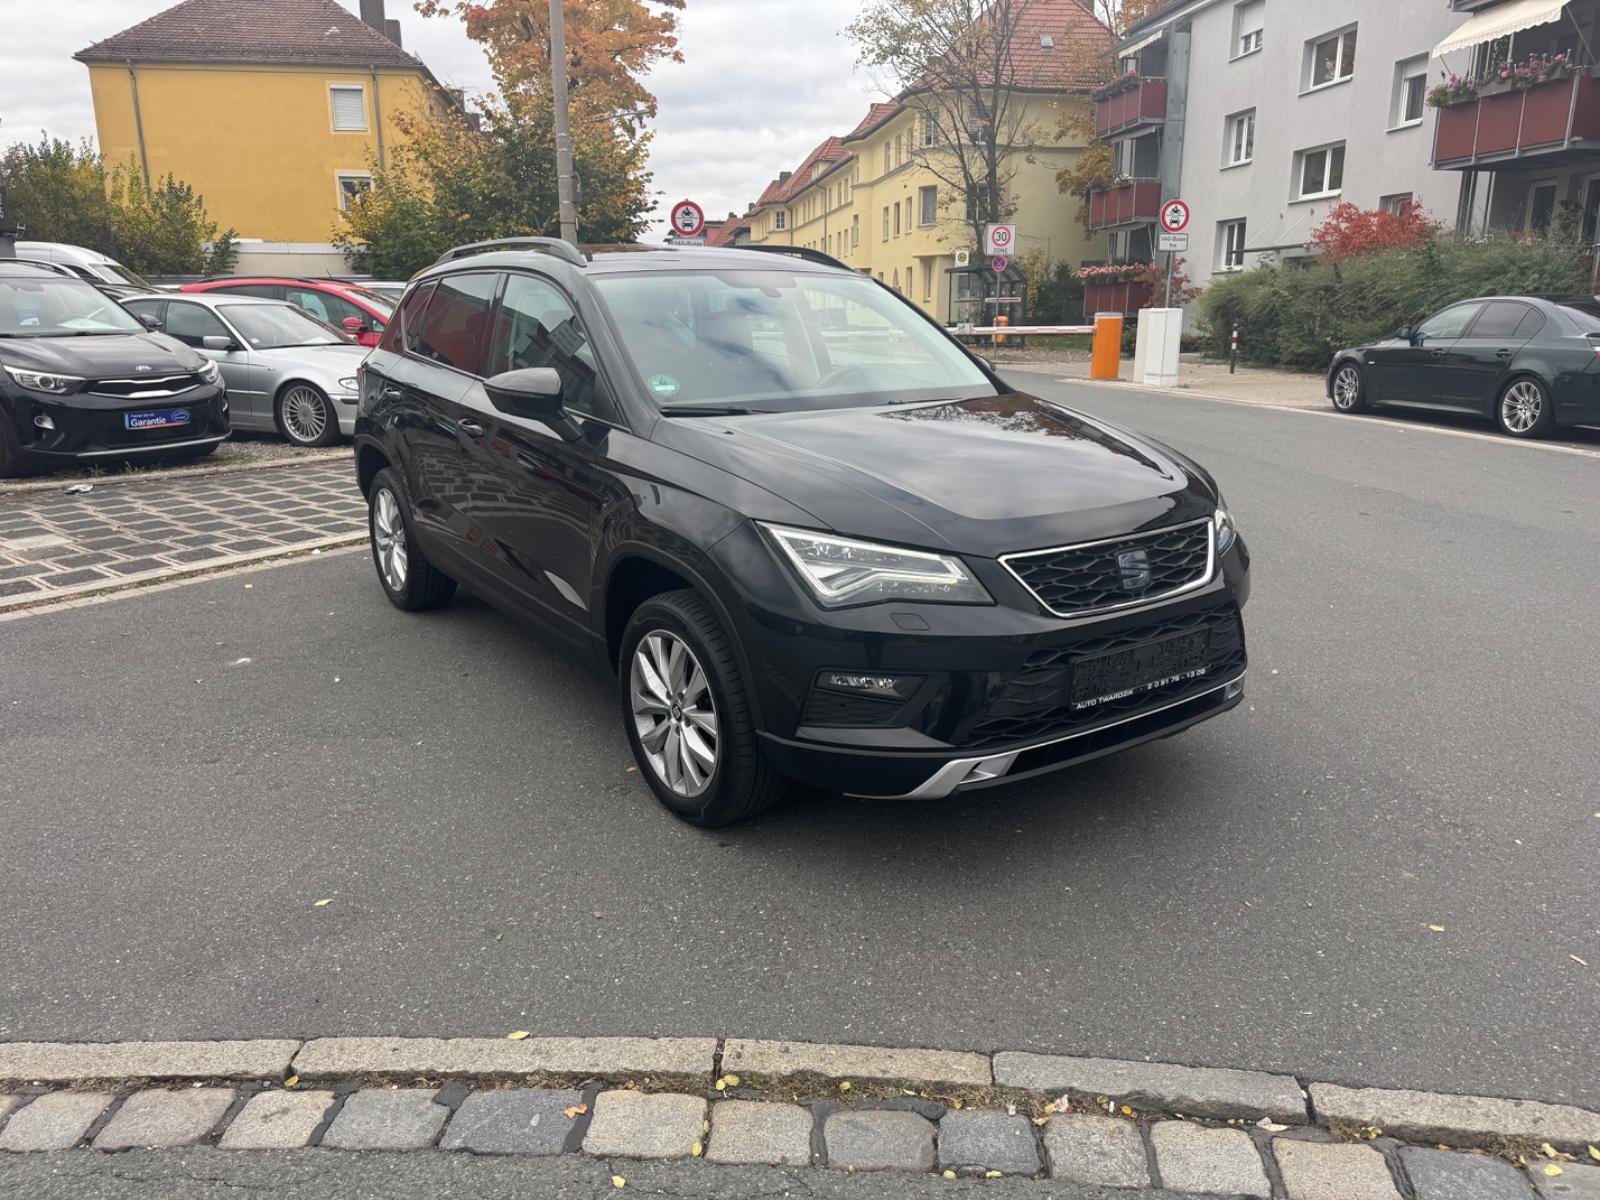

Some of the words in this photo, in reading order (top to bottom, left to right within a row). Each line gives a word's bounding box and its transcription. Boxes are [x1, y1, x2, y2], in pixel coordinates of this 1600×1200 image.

[995, 231, 1008, 242] 30
[131, 416, 167, 427] Garantie
[1075, 697, 1097, 710] AUTO
